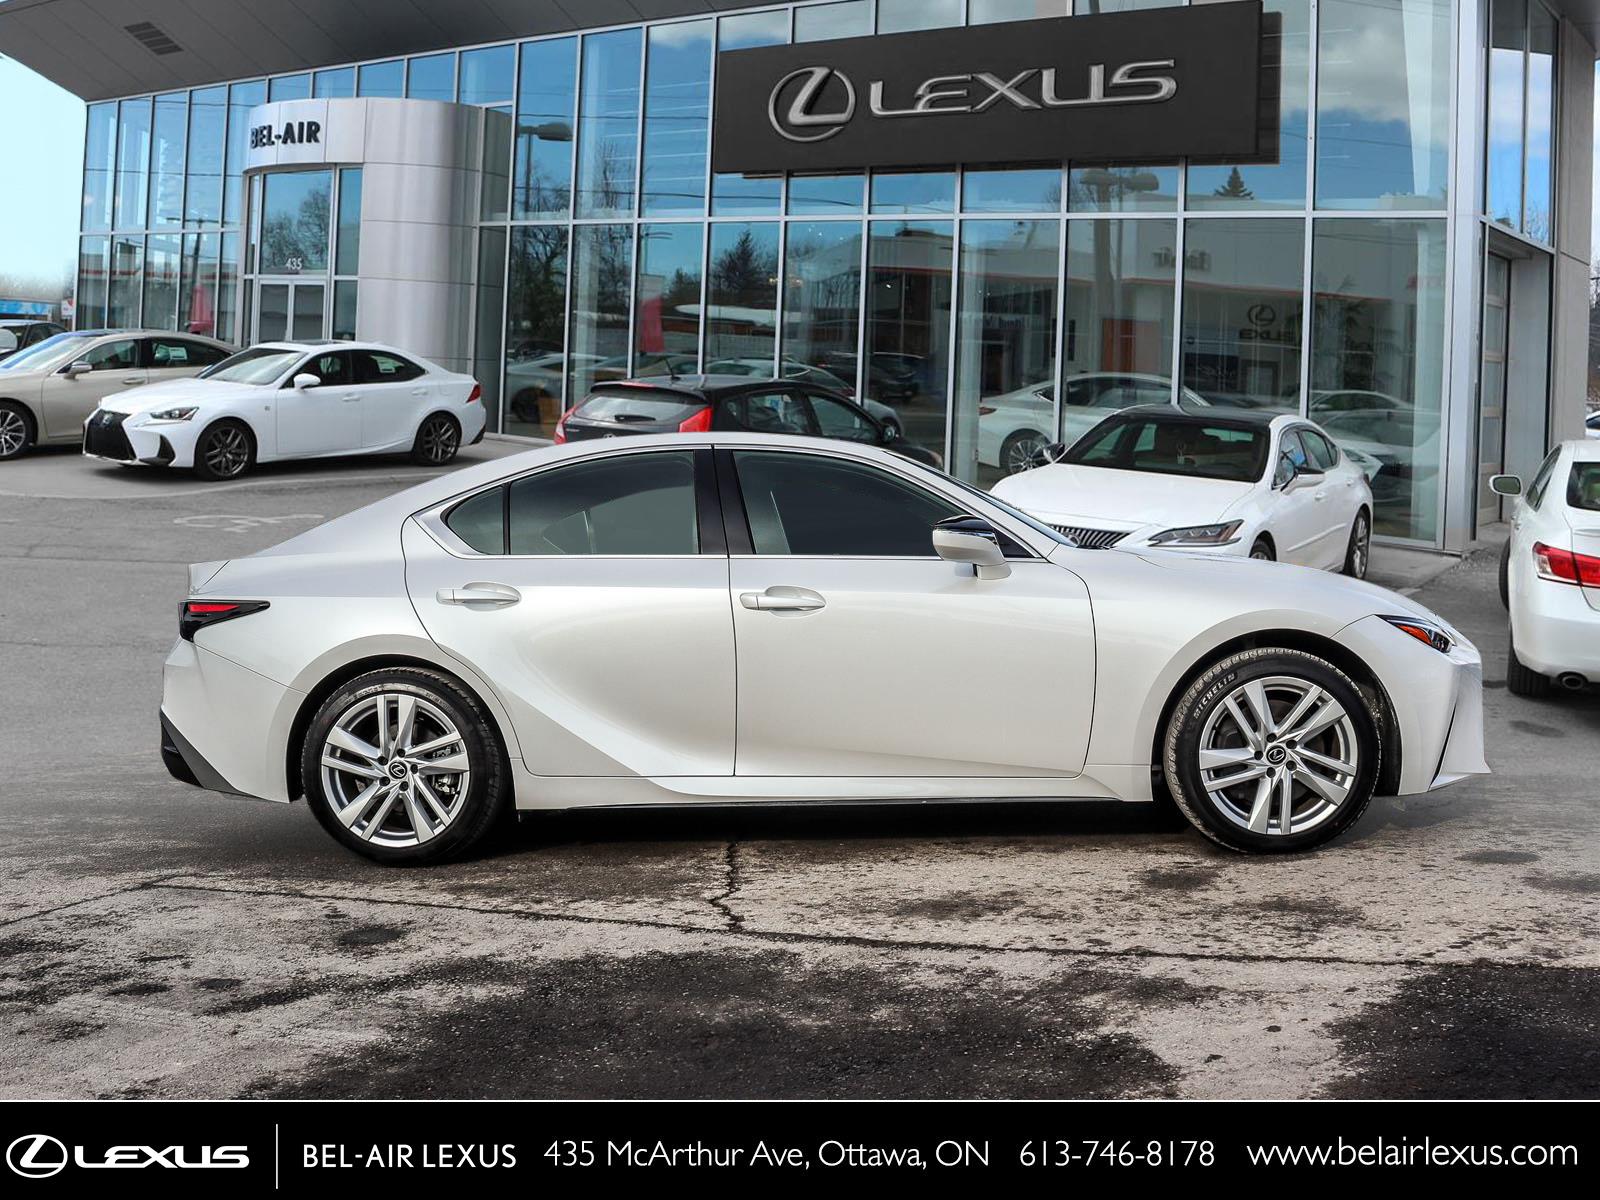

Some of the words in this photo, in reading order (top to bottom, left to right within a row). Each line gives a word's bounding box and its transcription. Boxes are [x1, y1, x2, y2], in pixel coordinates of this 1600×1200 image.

[869, 59, 1178, 117] LEXUS
[250, 121, 321, 149] BEL-AIR
[285, 257, 303, 271] 435
[1193, 673, 1235, 719] MICHELIN
